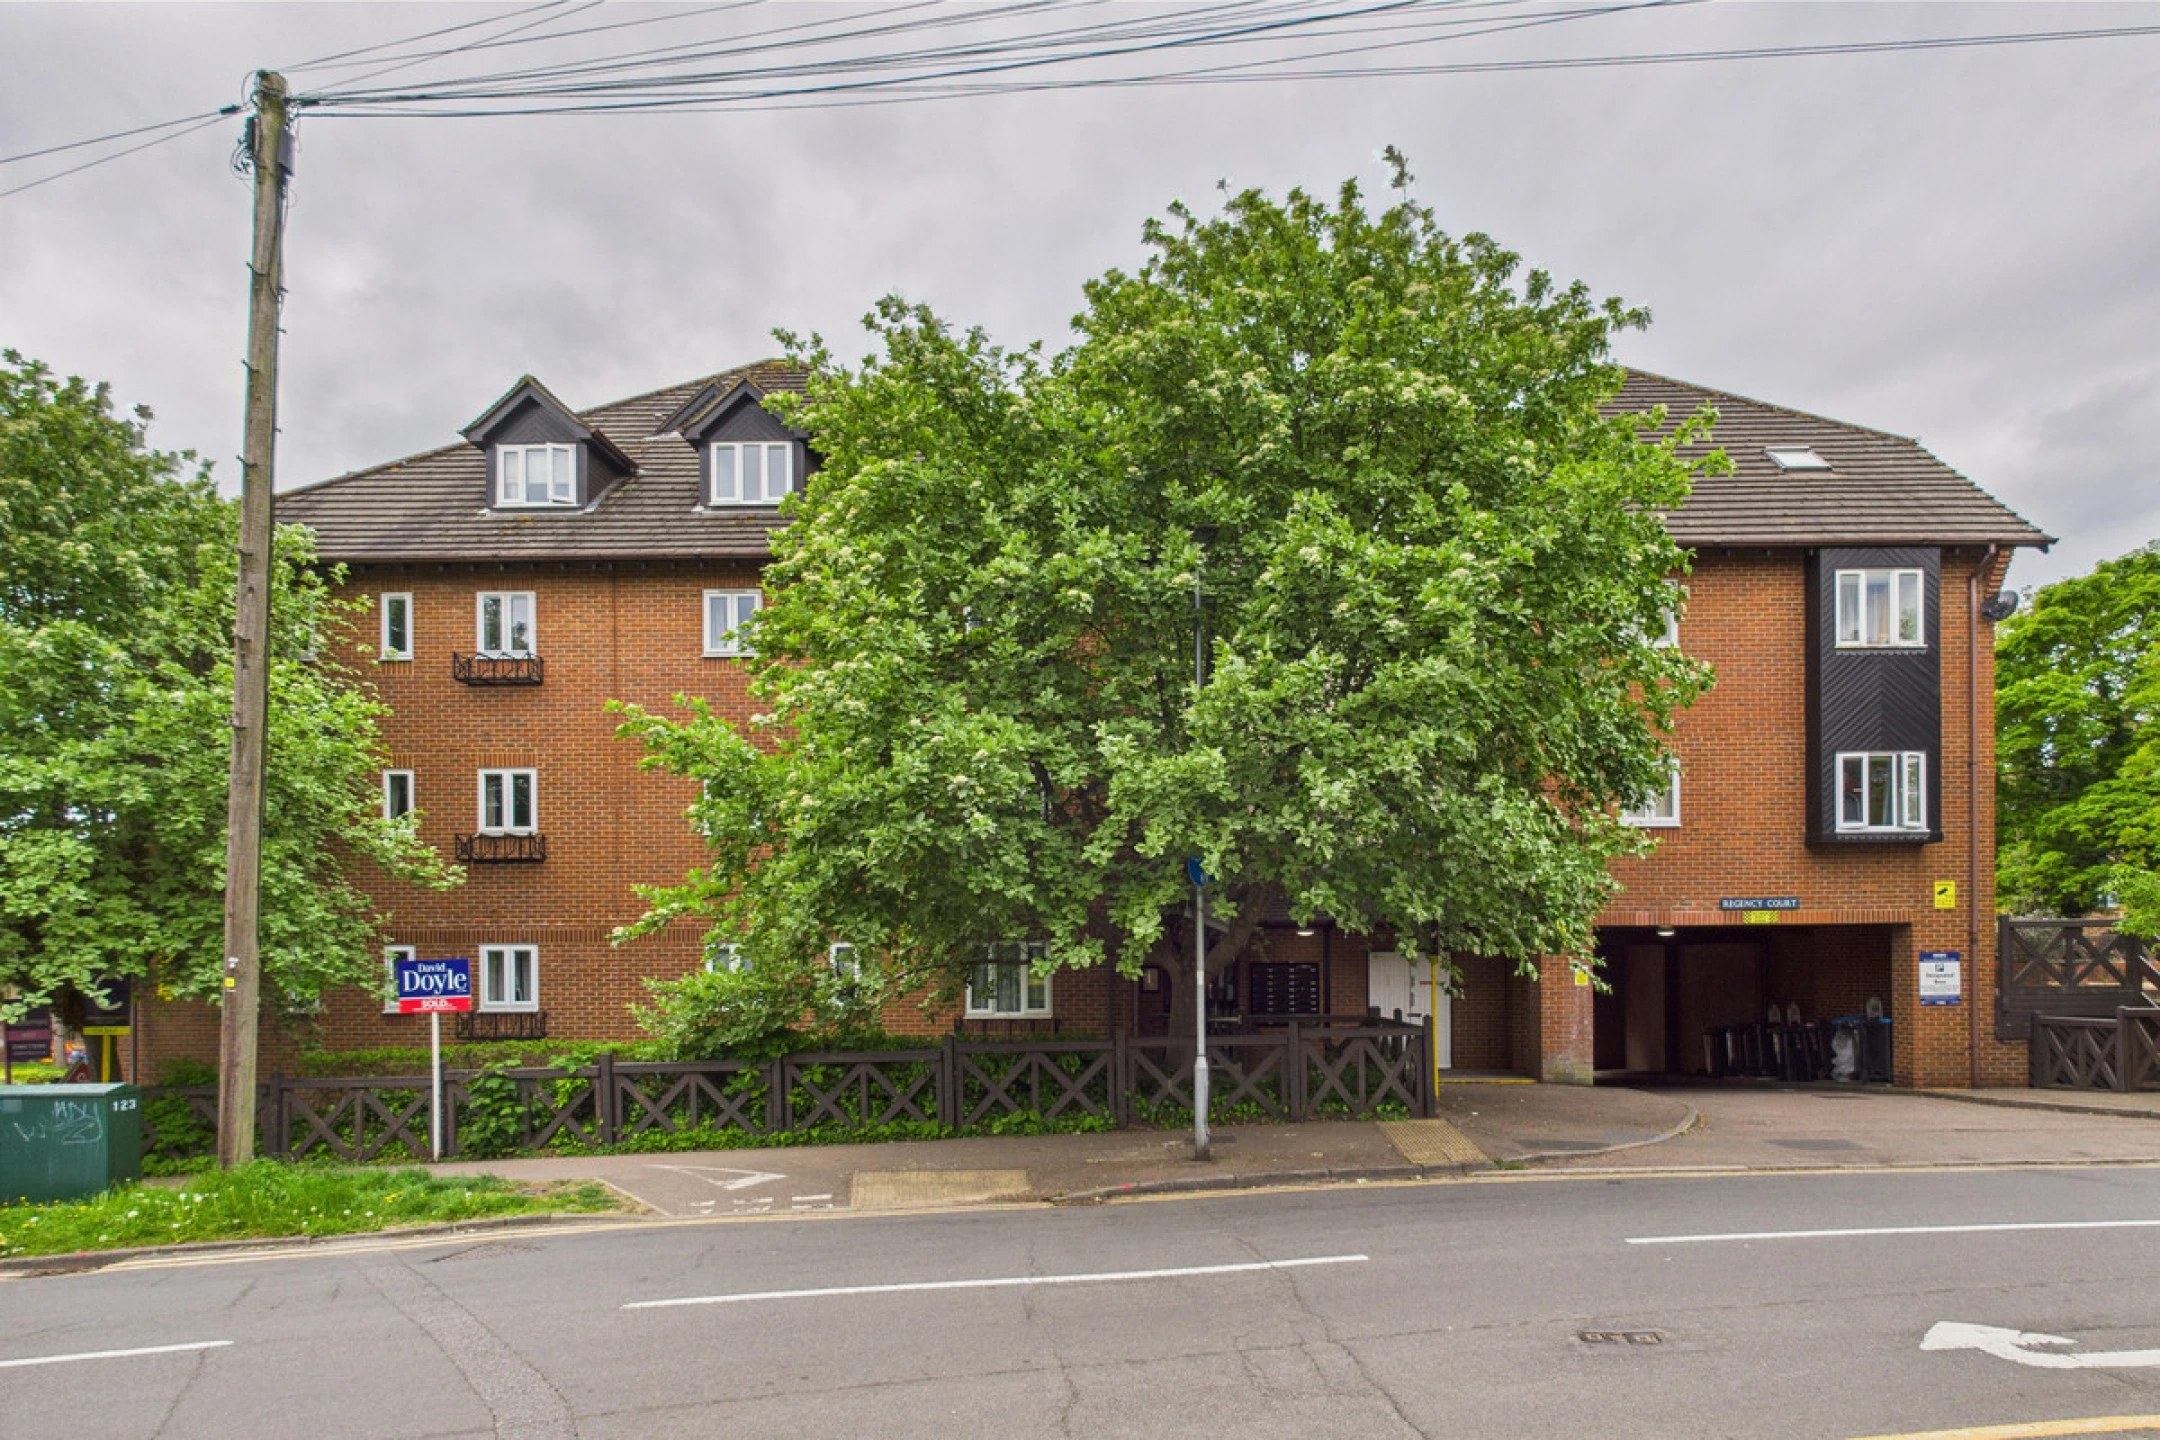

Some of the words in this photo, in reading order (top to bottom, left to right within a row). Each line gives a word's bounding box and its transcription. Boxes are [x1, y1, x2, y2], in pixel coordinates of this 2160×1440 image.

[1722, 899, 1762, 908] REGENCY
[1767, 899, 1797, 908] COURT
[417, 963, 446, 973] David
[403, 969, 467, 995] Doyle
[422, 999, 449, 1008] SOLD
[112, 1100, 136, 1112] 123
